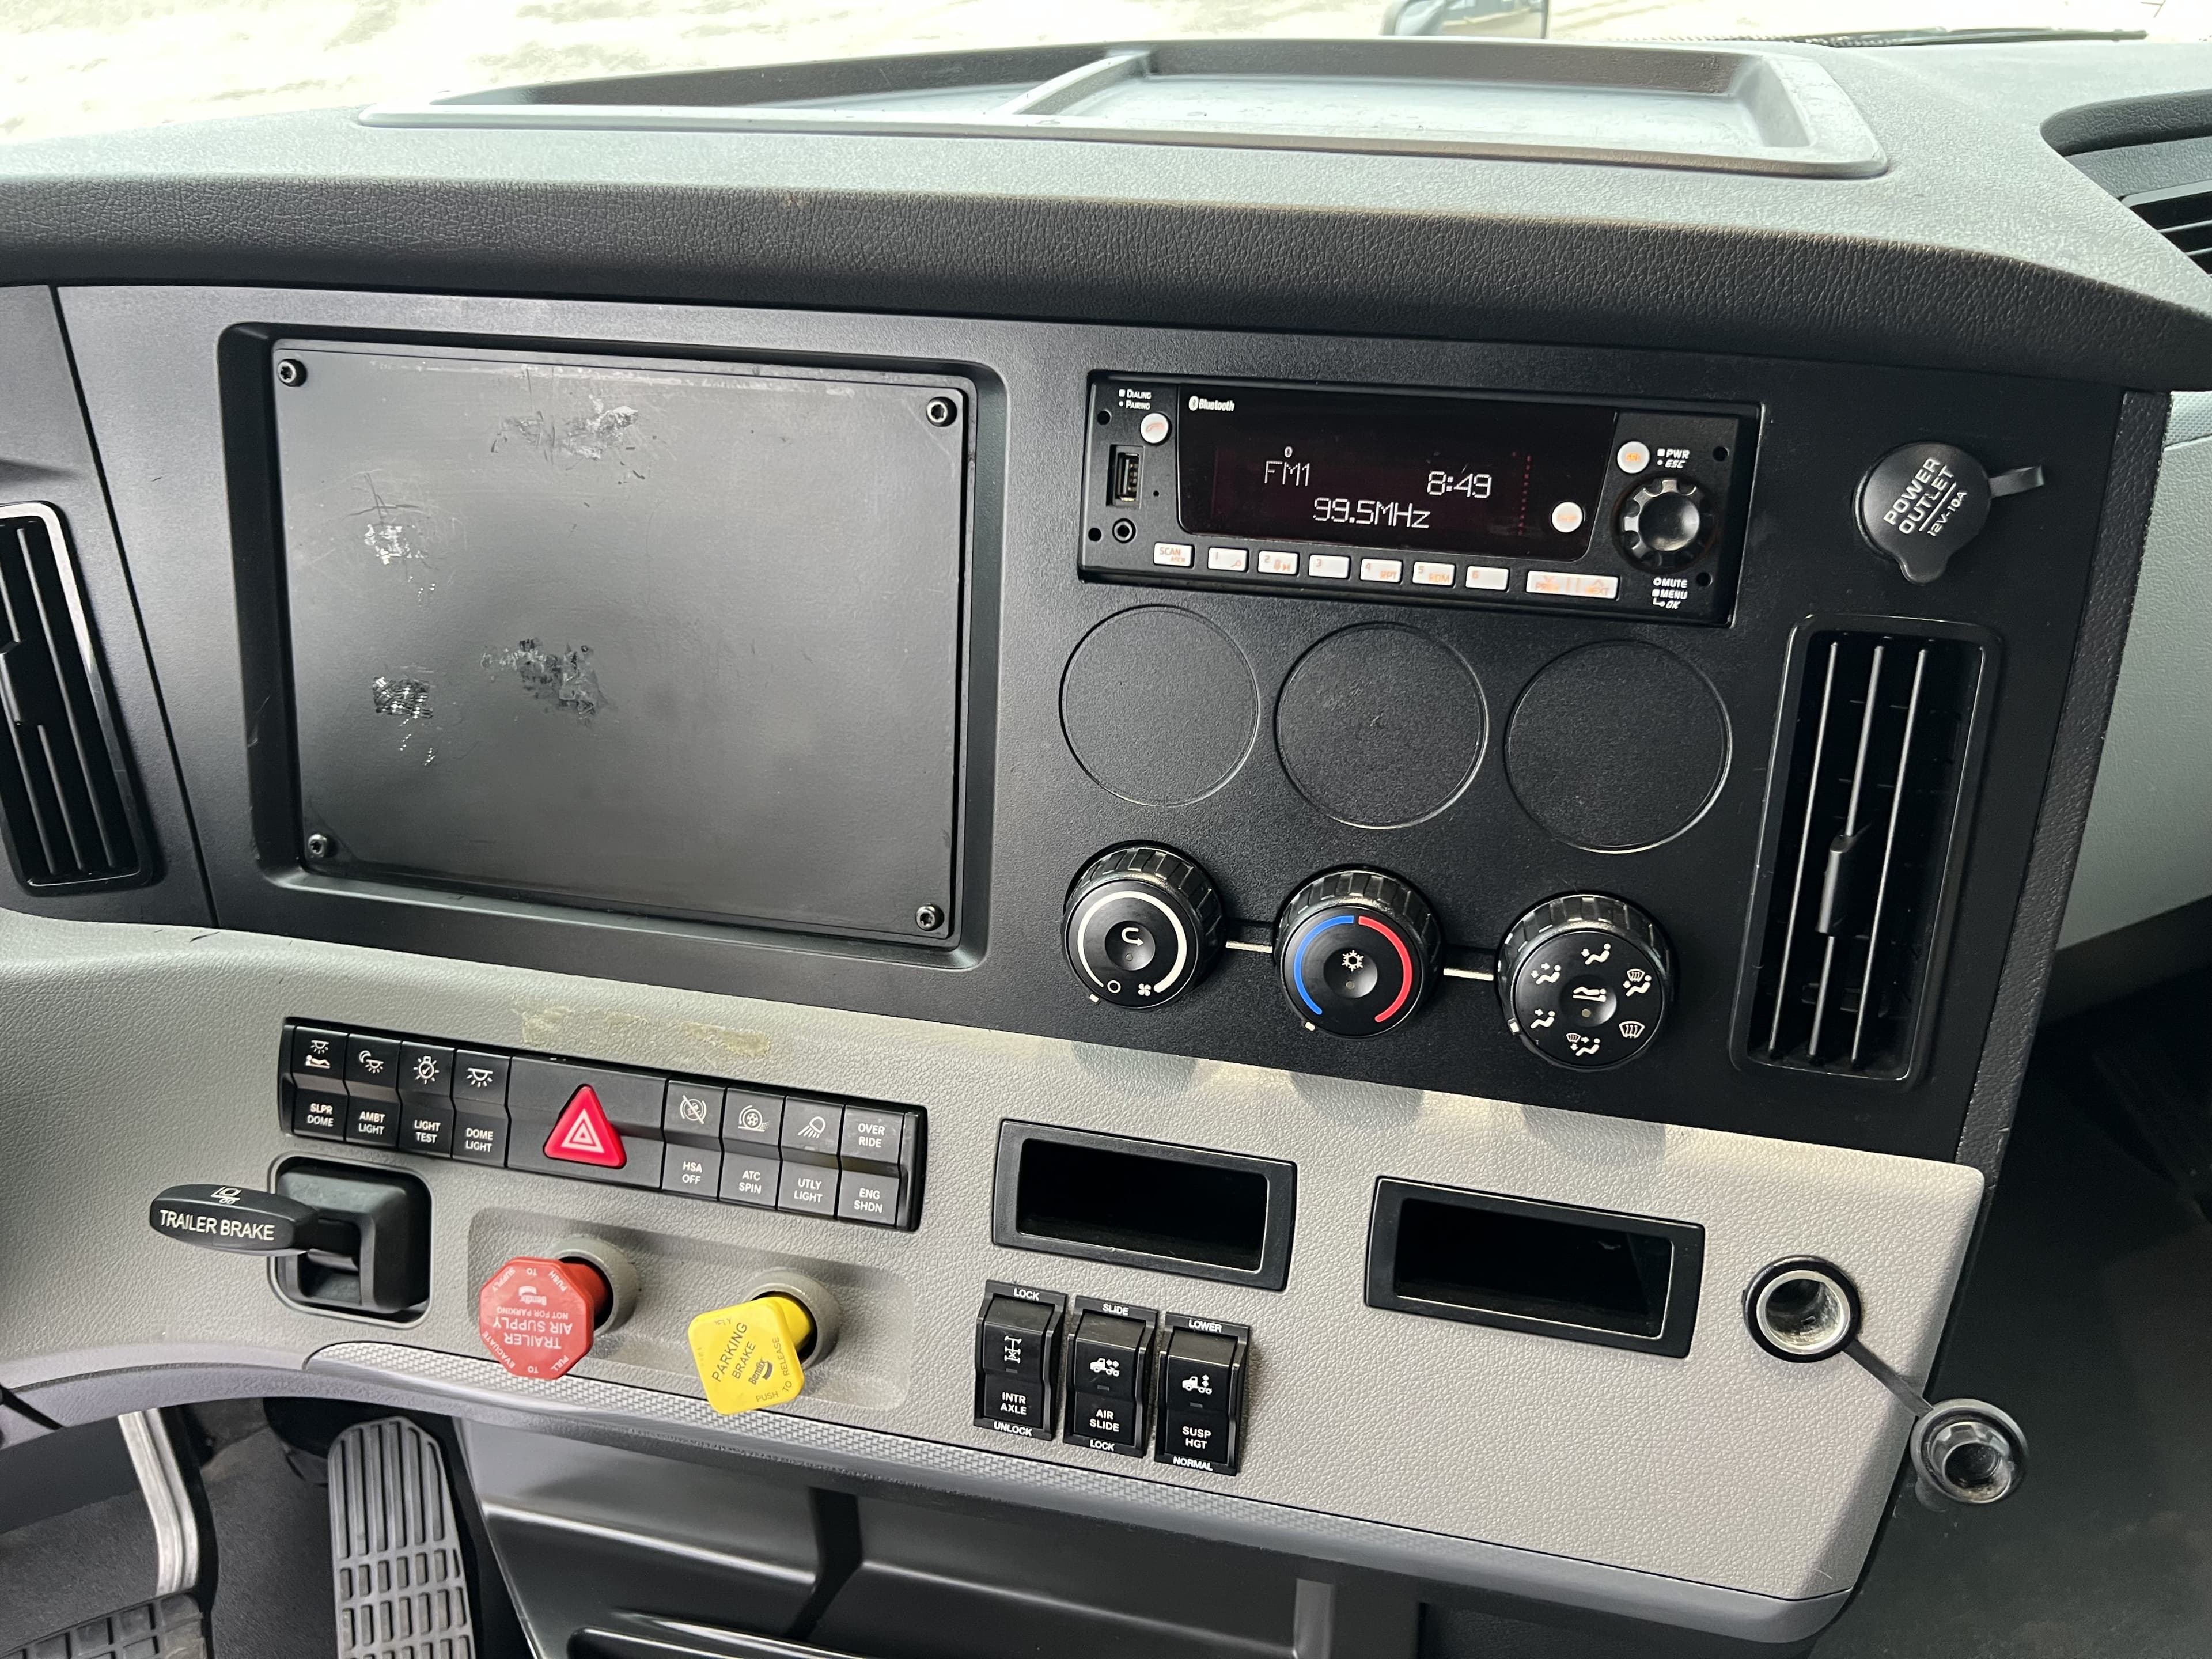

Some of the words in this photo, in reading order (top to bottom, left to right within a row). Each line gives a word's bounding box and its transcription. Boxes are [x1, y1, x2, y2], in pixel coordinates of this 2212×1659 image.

[1199, 399, 1235, 411] Bluetooth
[1666, 449, 1690, 459] PWR
[1665, 460, 1686, 468] ESC
[1264, 461, 1310, 487] FM1
[1427, 471, 1492, 499] 8:49
[1883, 457, 1940, 525] POWER
[1899, 465, 1955, 535] OUTLET
[1313, 497, 1431, 529] 99.5MHz
[1927, 490, 1967, 536] 12V-10A
[1160, 547, 1181, 555] SCAN
[1316, 559, 1321, 567] 3
[1365, 563, 1371, 571] 4
[1418, 565, 1425, 573] 5
[1380, 571, 1397, 579] RPT
[1661, 578, 1688, 588] MUTE
[1660, 589, 1688, 599] MENU
[1665, 600, 1681, 609] OK
[310, 1103, 333, 1115] SLPR
[307, 1115, 334, 1127] DOME
[359, 1111, 385, 1123] AMBT
[358, 1123, 385, 1135] LIGHT
[414, 1120, 441, 1132] LIGHT
[858, 1123, 885, 1135] OVER
[416, 1131, 437, 1143] TEST
[466, 1128, 494, 1141] DOME
[465, 1141, 492, 1153] LIGHT
[859, 1136, 882, 1148] RIDE
[683, 1161, 703, 1173] HSA
[682, 1173, 701, 1185] OFF
[742, 1170, 761, 1182] ATC
[738, 1182, 762, 1194] SPIN
[798, 1178, 822, 1191] UTLY
[794, 1190, 823, 1203] LIGHT
[859, 1188, 881, 1200] ENG
[854, 1200, 883, 1213] SHDN
[160, 1209, 217, 1234] TRAILER
[220, 1220, 275, 1241] BRAKE
[492, 1267, 516, 1292] SUPPLY
[548, 1271, 568, 1291] PUSH
[1013, 1287, 1040, 1301] LOCK
[497, 1306, 531, 1316] PARKING
[1102, 1303, 1129, 1316] SLIDE
[493, 1316, 546, 1332] SUPPLY
[550, 1323, 573, 1335] AIR
[1188, 1319, 1222, 1333] LOWER
[503, 1332, 562, 1349] TRAILER
[482, 1331, 516, 1369] EVACUATE
[712, 1322, 747, 1382] PARKING
[772, 1336, 790, 1376] RELEASE
[551, 1355, 569, 1372] PULL
[732, 1341, 756, 1379] BRAKE
[528, 1365, 539, 1373] TO
[748, 1357, 767, 1385] Bendix
[782, 1380, 792, 1392] TO
[756, 1391, 779, 1402] PUSH
[1002, 1391, 1027, 1404] INTR
[1000, 1403, 1027, 1415] AXLE
[1096, 1408, 1114, 1420] AIR
[994, 1421, 1032, 1437] UNLOCK
[1089, 1418, 1120, 1433] SLIDE
[1182, 1426, 1211, 1438] SUSP
[1090, 1440, 1115, 1452] LOCK
[1185, 1438, 1207, 1449] HGT
[1173, 1456, 1213, 1471] NORMAL
